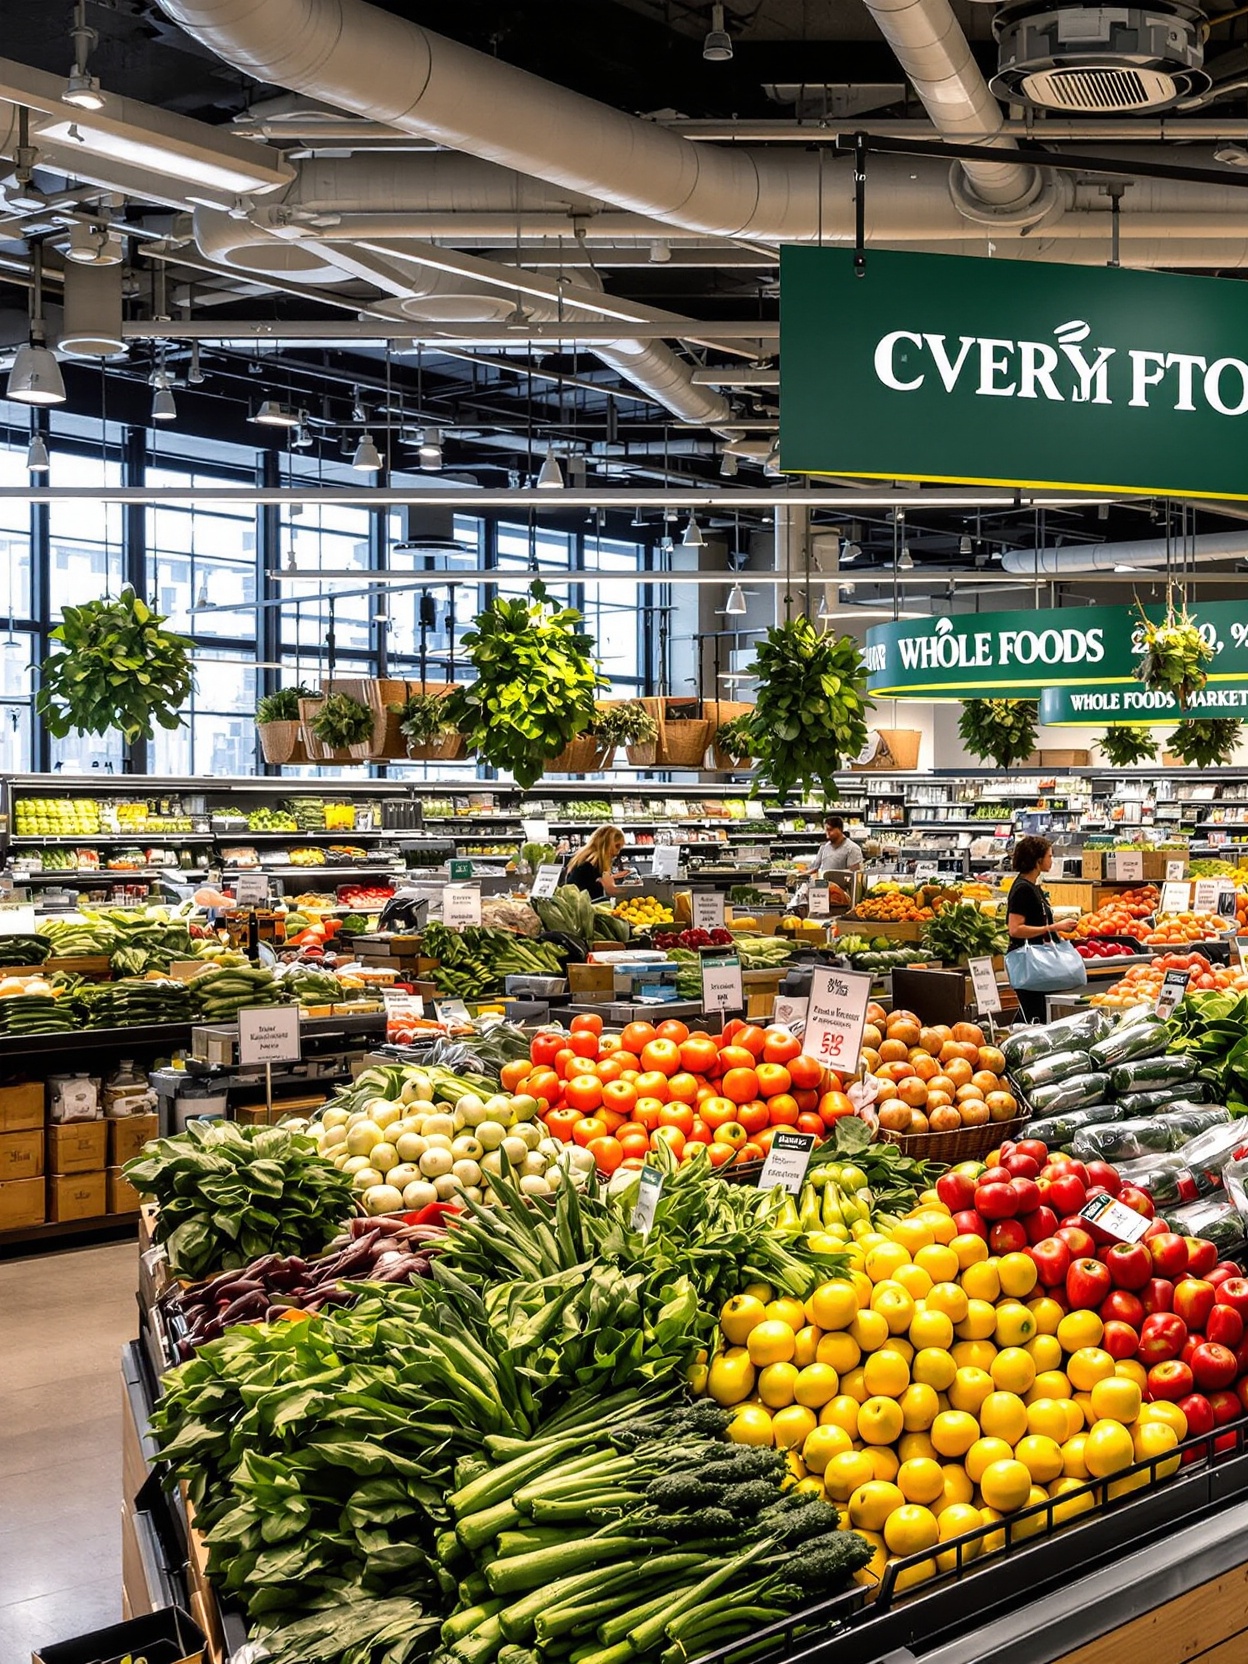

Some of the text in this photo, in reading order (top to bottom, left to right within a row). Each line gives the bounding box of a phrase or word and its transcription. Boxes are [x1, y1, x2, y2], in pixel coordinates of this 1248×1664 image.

[898, 632, 992, 670] WHOLE
[998, 628, 1105, 666] FOODS
[1070, 693, 1120, 711] WHOLE
[1123, 690, 1176, 710] FOODS
